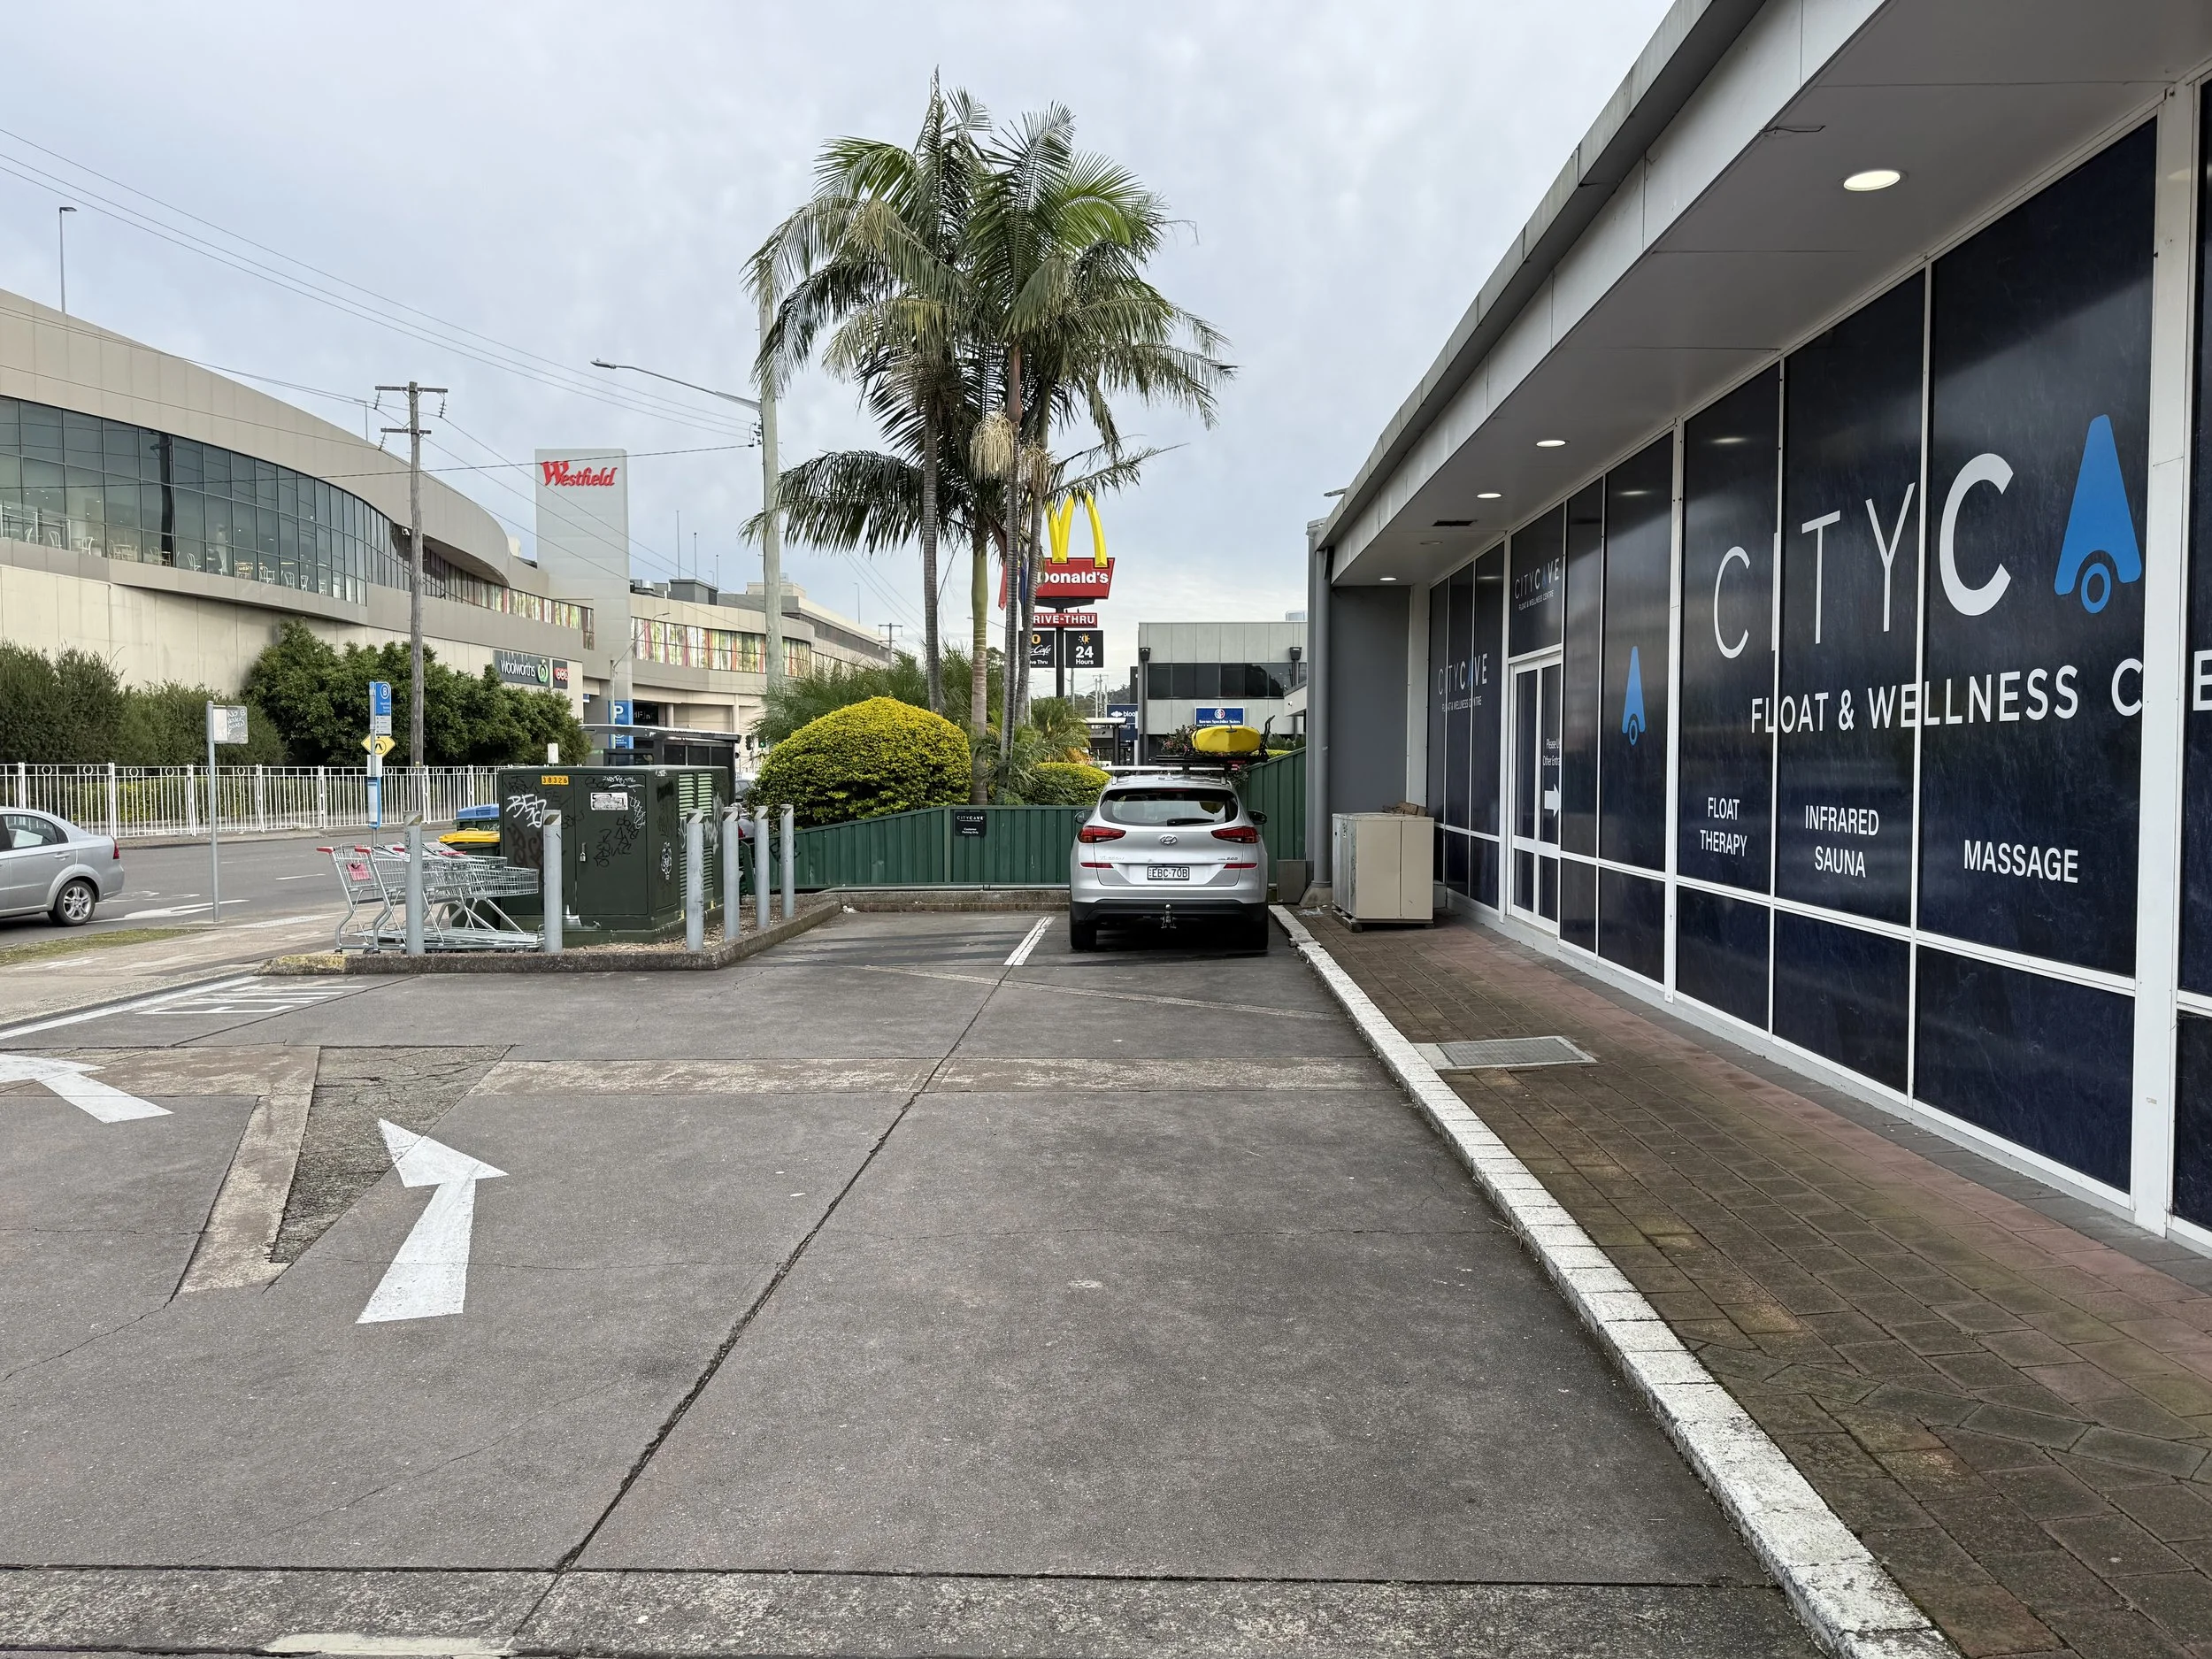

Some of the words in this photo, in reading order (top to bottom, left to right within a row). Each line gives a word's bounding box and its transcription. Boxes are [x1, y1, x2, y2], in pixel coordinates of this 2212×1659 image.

[540, 461, 618, 487] Westfield
[1037, 571, 1109, 584] Donald's
[1033, 615, 1094, 625] RIVE-THRU
[1075, 646, 1094, 658] 24
[500, 659, 535, 678] Woolworths
[614, 705, 624, 718] P
[1751, 692, 1829, 733] FLOAT
[1838, 689, 1855, 732] &
[1868, 664, 2078, 728] WELLNESS
[1708, 797, 1740, 821] FLOAT
[1805, 805, 1879, 836] INFRARED
[1700, 829, 1747, 856] THERAPY
[1814, 846, 1866, 878] SAUNA
[1963, 840, 2078, 883] MASSAGE
[134, 985, 367, 1015] EXIT
